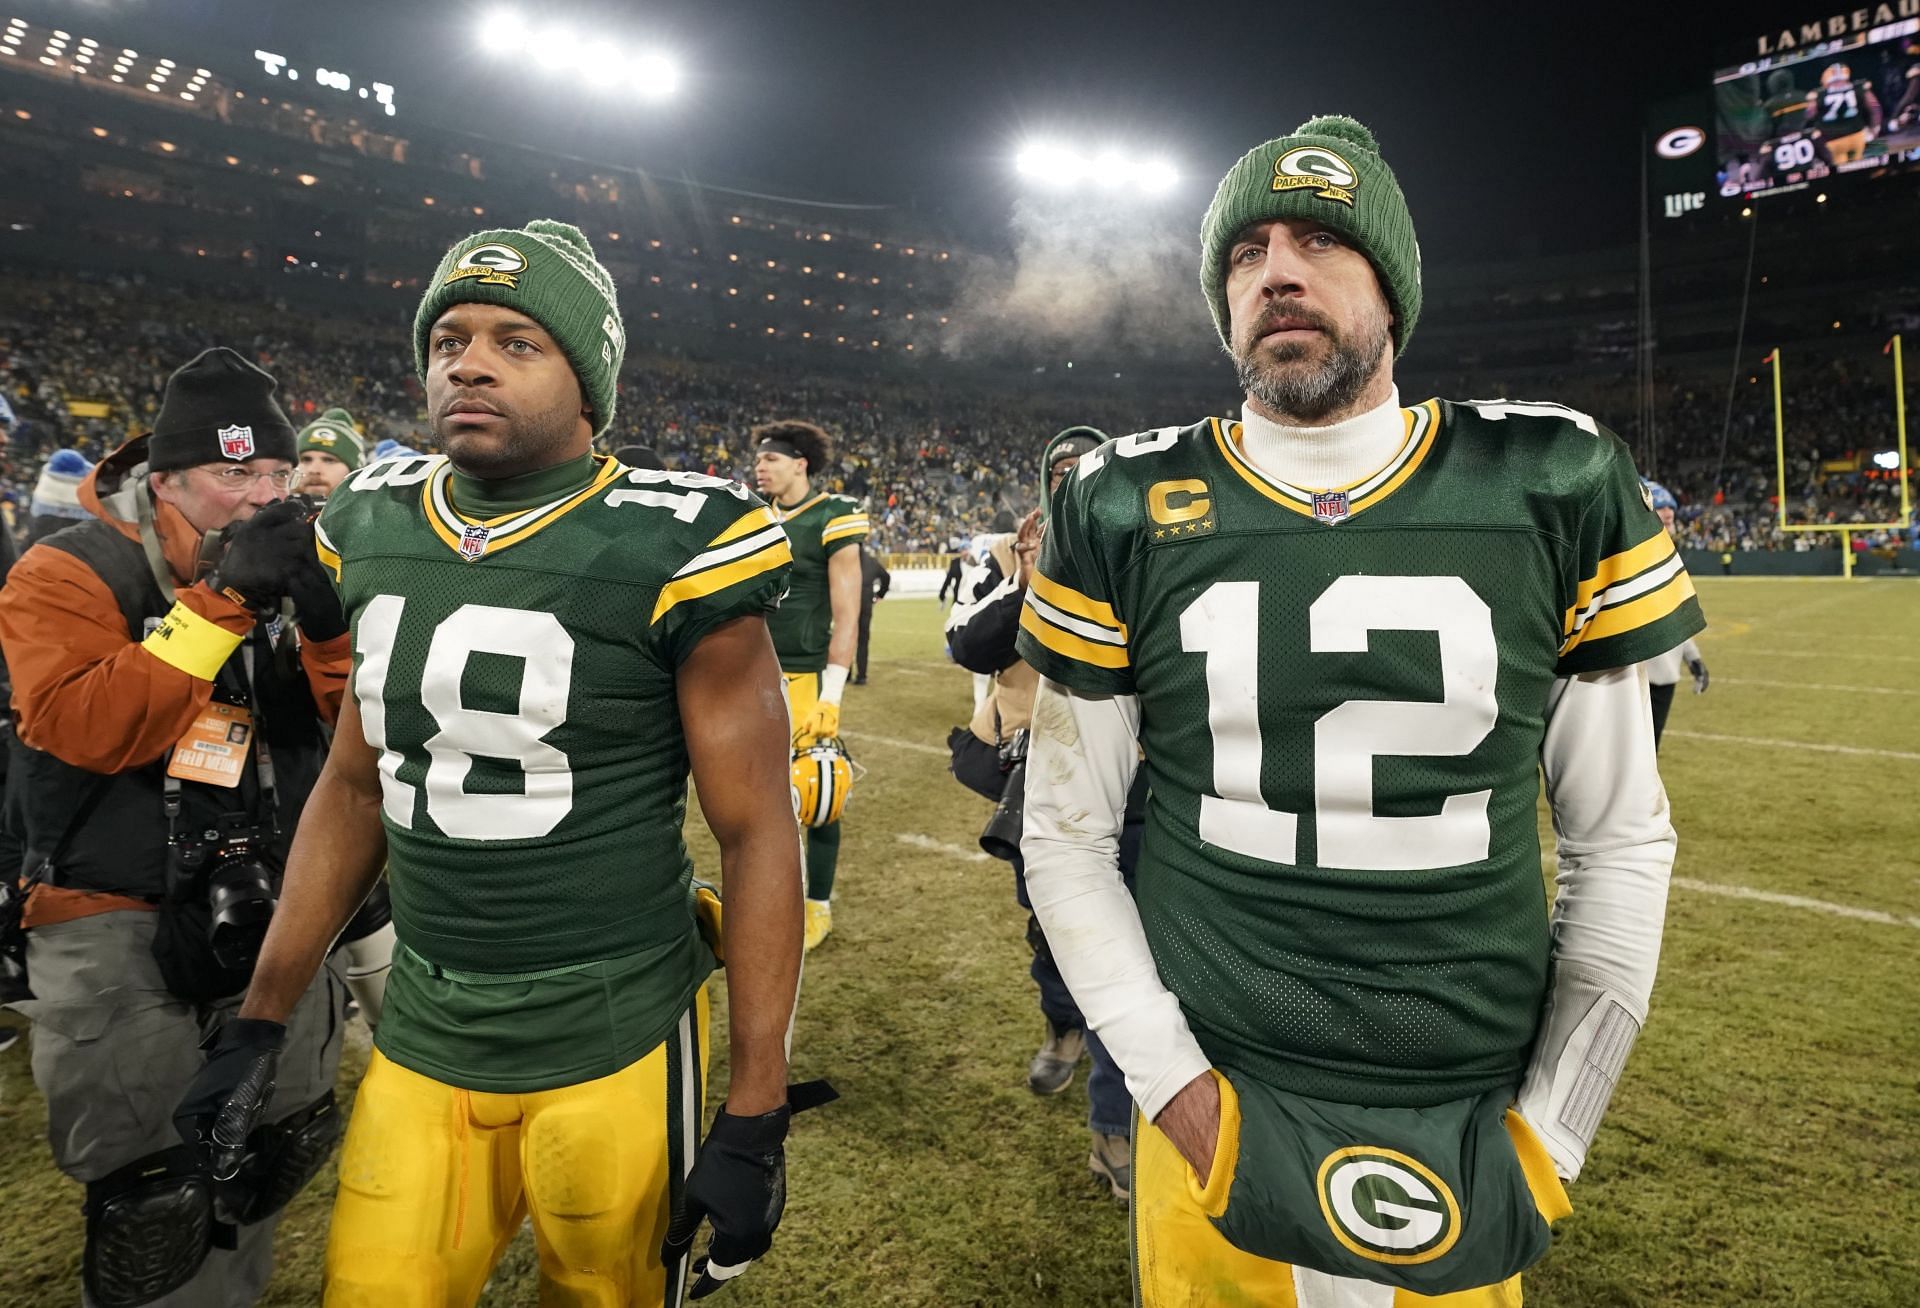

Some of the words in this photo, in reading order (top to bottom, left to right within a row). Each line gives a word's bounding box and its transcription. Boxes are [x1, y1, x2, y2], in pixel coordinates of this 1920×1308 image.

[1757, 0, 1920, 55] LAMBEAU
[1822, 89, 1858, 122] 71
[1774, 138, 1814, 170] 90
[1274, 176, 1328, 188] PACKERS
[1665, 191, 1705, 218] Lite
[223, 440, 250, 455] NFL
[1148, 478, 1210, 525] C
[1317, 501, 1345, 516] NFL
[463, 537, 481, 553] NFL
[355, 594, 575, 841] 18
[1179, 575, 1499, 870] 12
